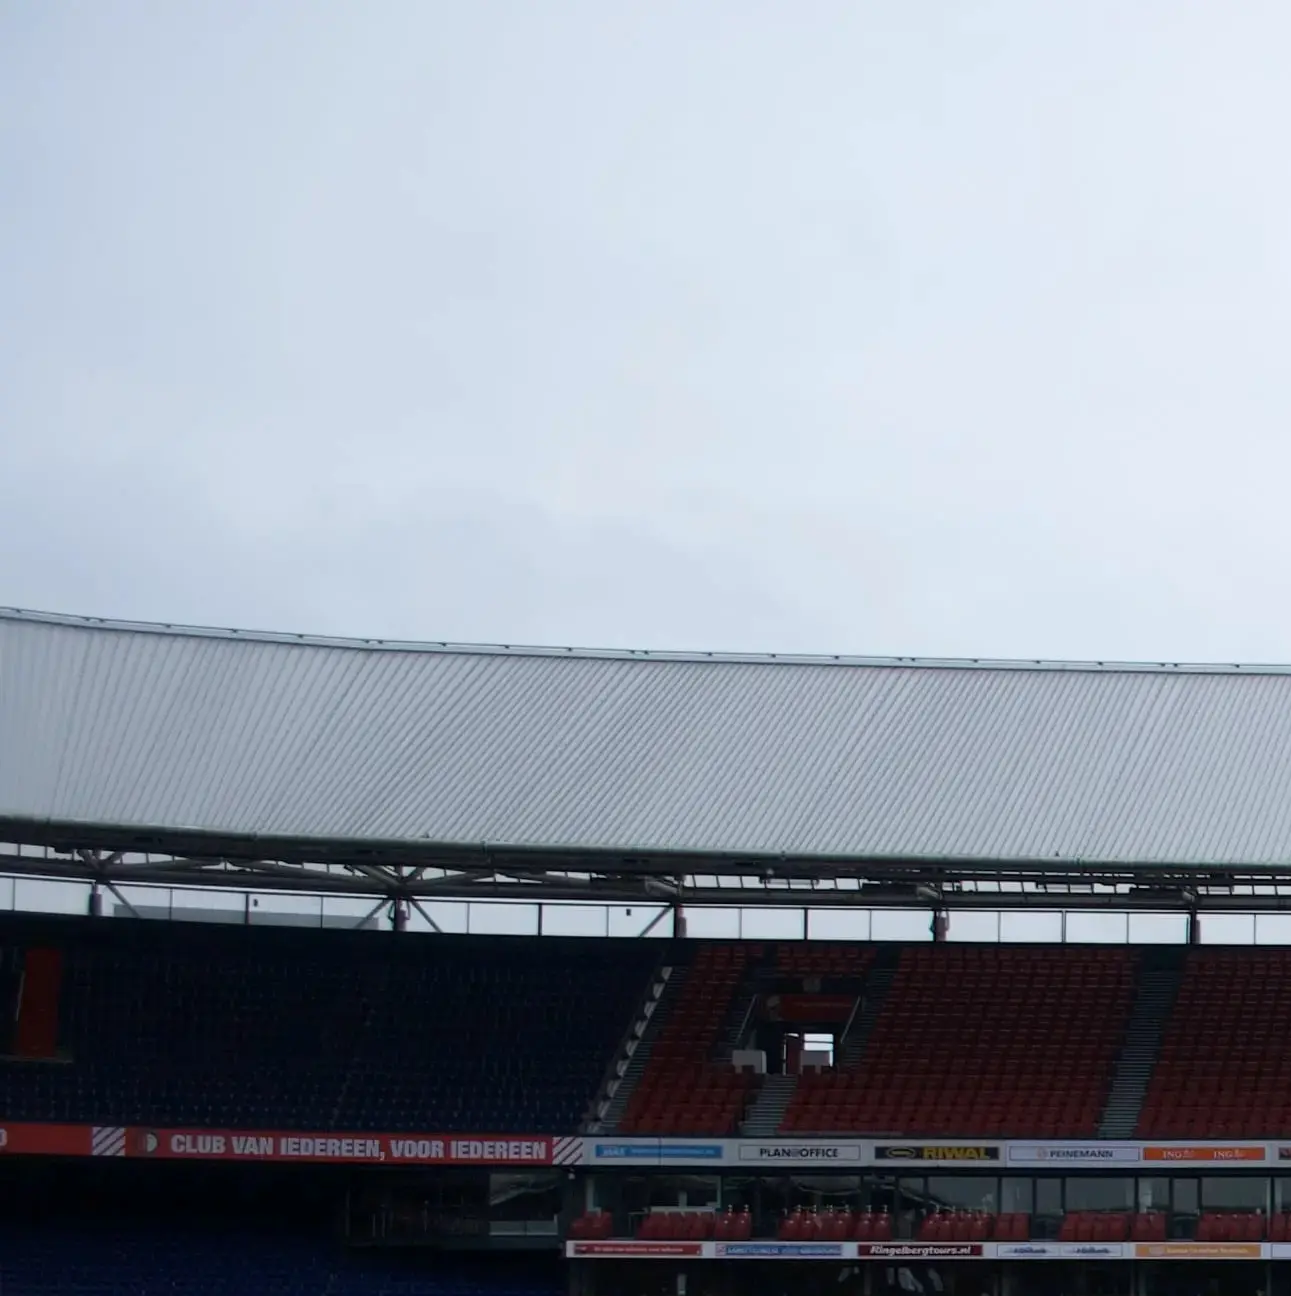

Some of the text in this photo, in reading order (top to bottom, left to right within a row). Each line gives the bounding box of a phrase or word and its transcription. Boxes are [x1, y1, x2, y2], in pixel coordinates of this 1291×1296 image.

[170, 1134, 547, 1161] CLUB VAN IEDEREEN, VOOR IEDEREEN
[921, 1147, 991, 1160] RIWAL
[1163, 1150, 1183, 1160] ING
[1213, 1150, 1232, 1160] ING
